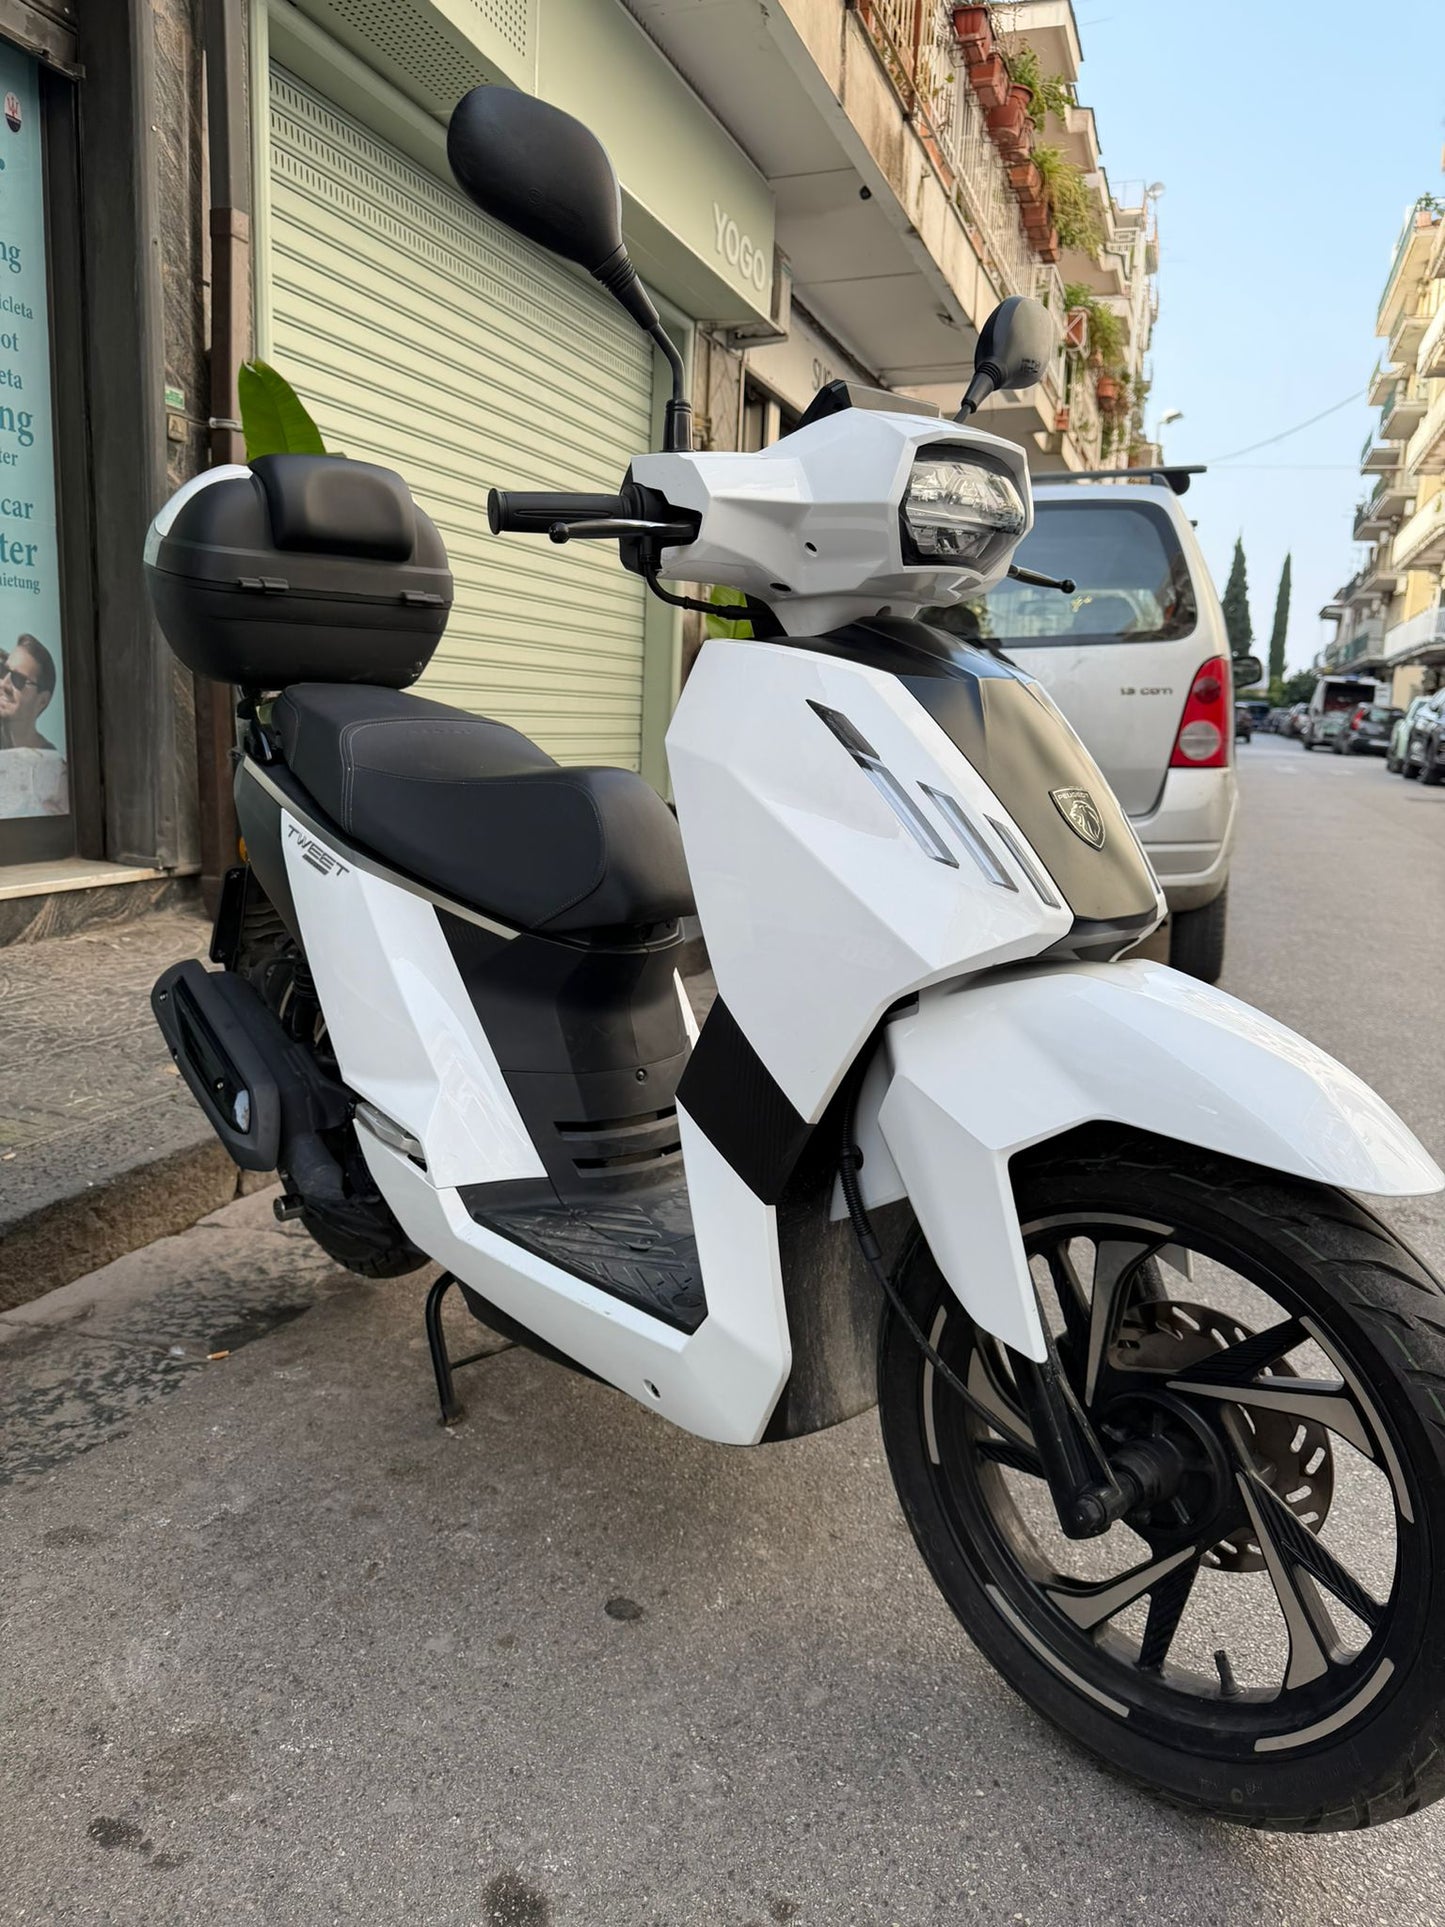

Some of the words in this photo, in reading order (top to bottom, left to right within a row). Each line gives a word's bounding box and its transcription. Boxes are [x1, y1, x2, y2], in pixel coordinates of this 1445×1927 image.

[712, 200, 766, 292] YOGO
[1, 497, 34, 519] car
[0, 573, 41, 595] ietung
[287, 824, 350, 876] TWEET
